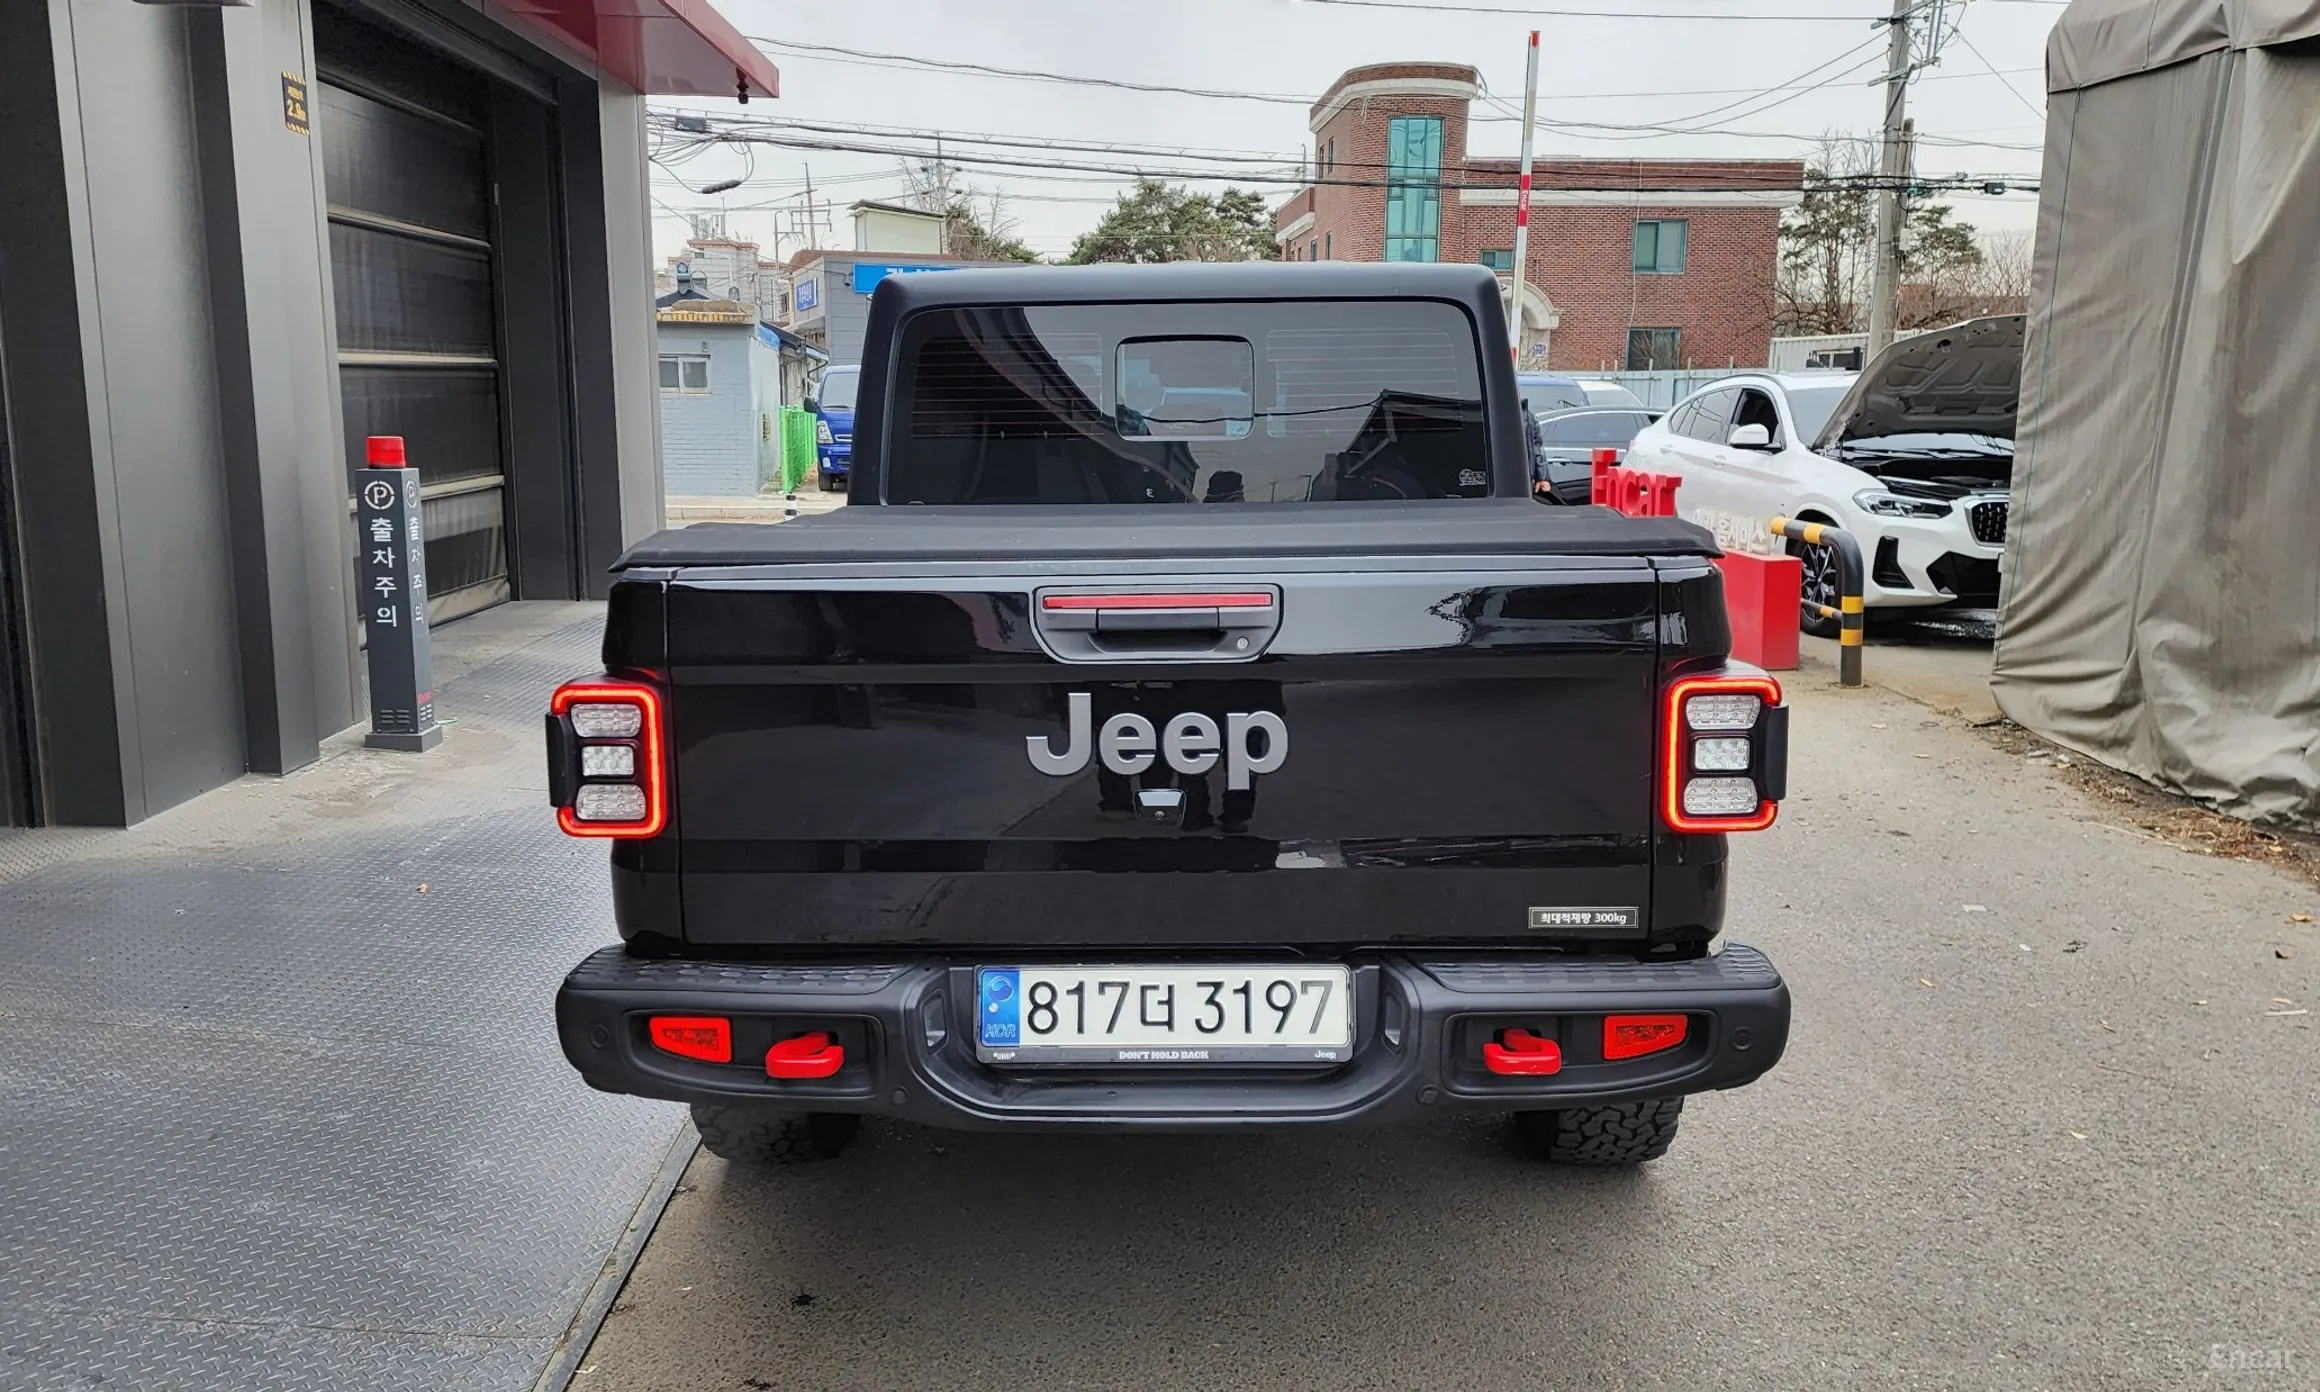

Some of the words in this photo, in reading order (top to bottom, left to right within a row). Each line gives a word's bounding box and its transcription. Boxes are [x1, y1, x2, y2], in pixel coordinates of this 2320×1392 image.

[370, 517, 398, 628] 출차주의
[1026, 692, 1289, 790] Jeep
[1541, 912, 1592, 924] 최대적재량
[1595, 912, 1627, 925] 300kg
[1027, 980, 1175, 1035] 817더
[1194, 979, 1334, 1035] 3197
[985, 1023, 1016, 1038] KOR
[1119, 1051, 1150, 1060] DON'T
[1151, 1051, 1179, 1060] HOLD
[1181, 1051, 1209, 1060] BACK
[1315, 1050, 1337, 1060] Jeep
